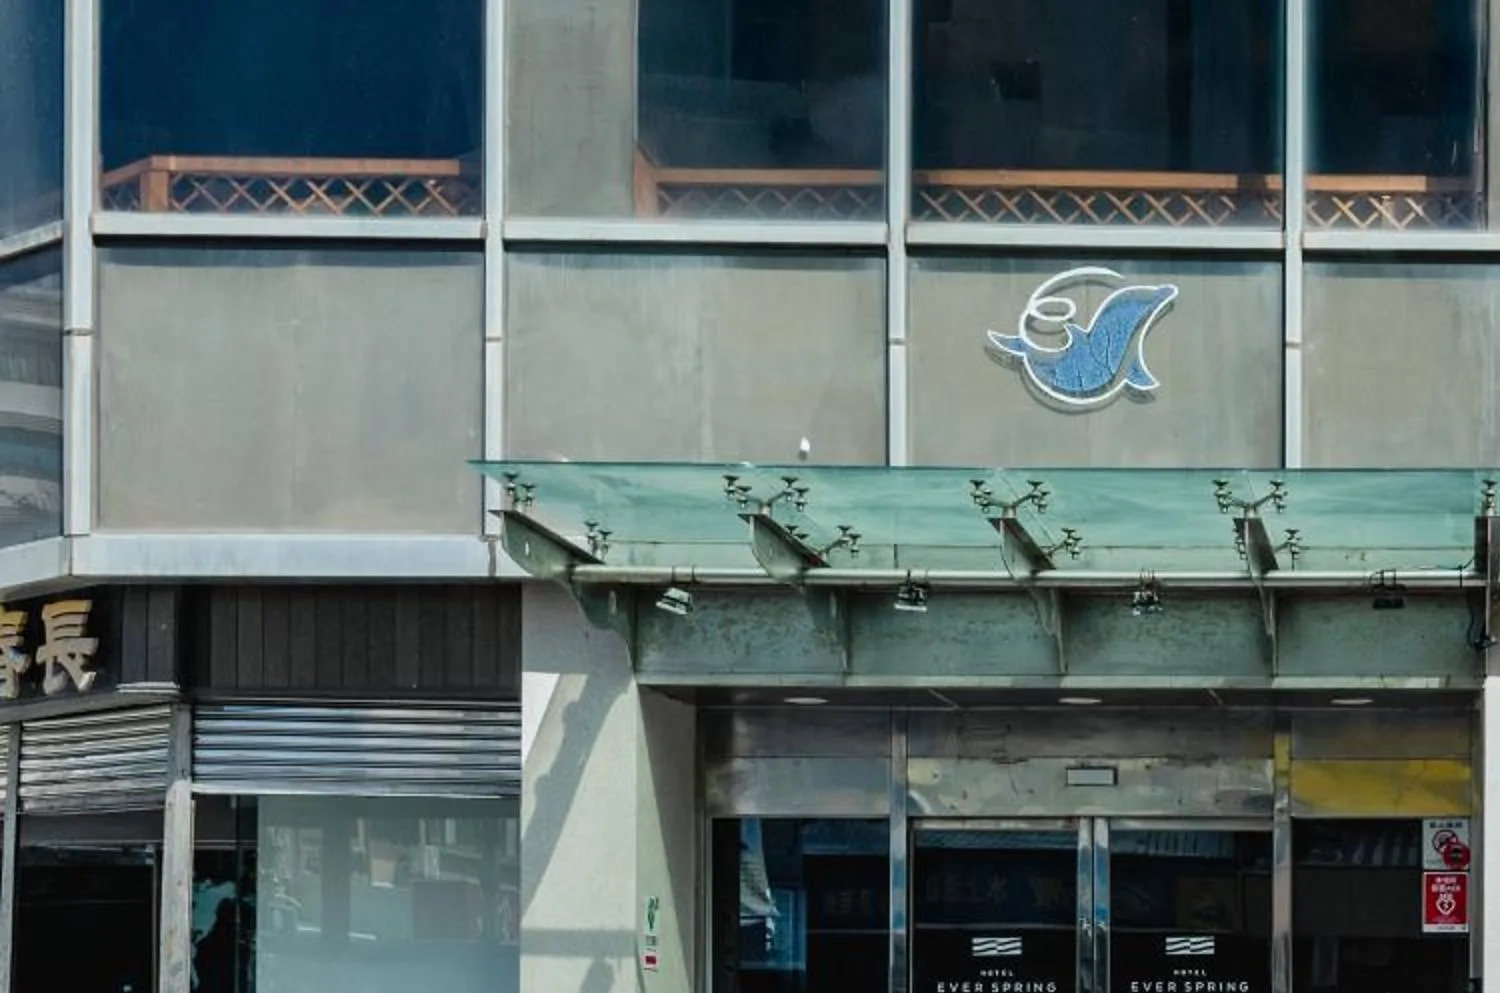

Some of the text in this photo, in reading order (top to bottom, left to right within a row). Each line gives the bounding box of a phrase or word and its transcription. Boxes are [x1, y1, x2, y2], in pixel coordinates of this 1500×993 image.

[937, 981, 1057, 993] EVER SPRING
[1131, 981, 1250, 993] EVER SPRING
